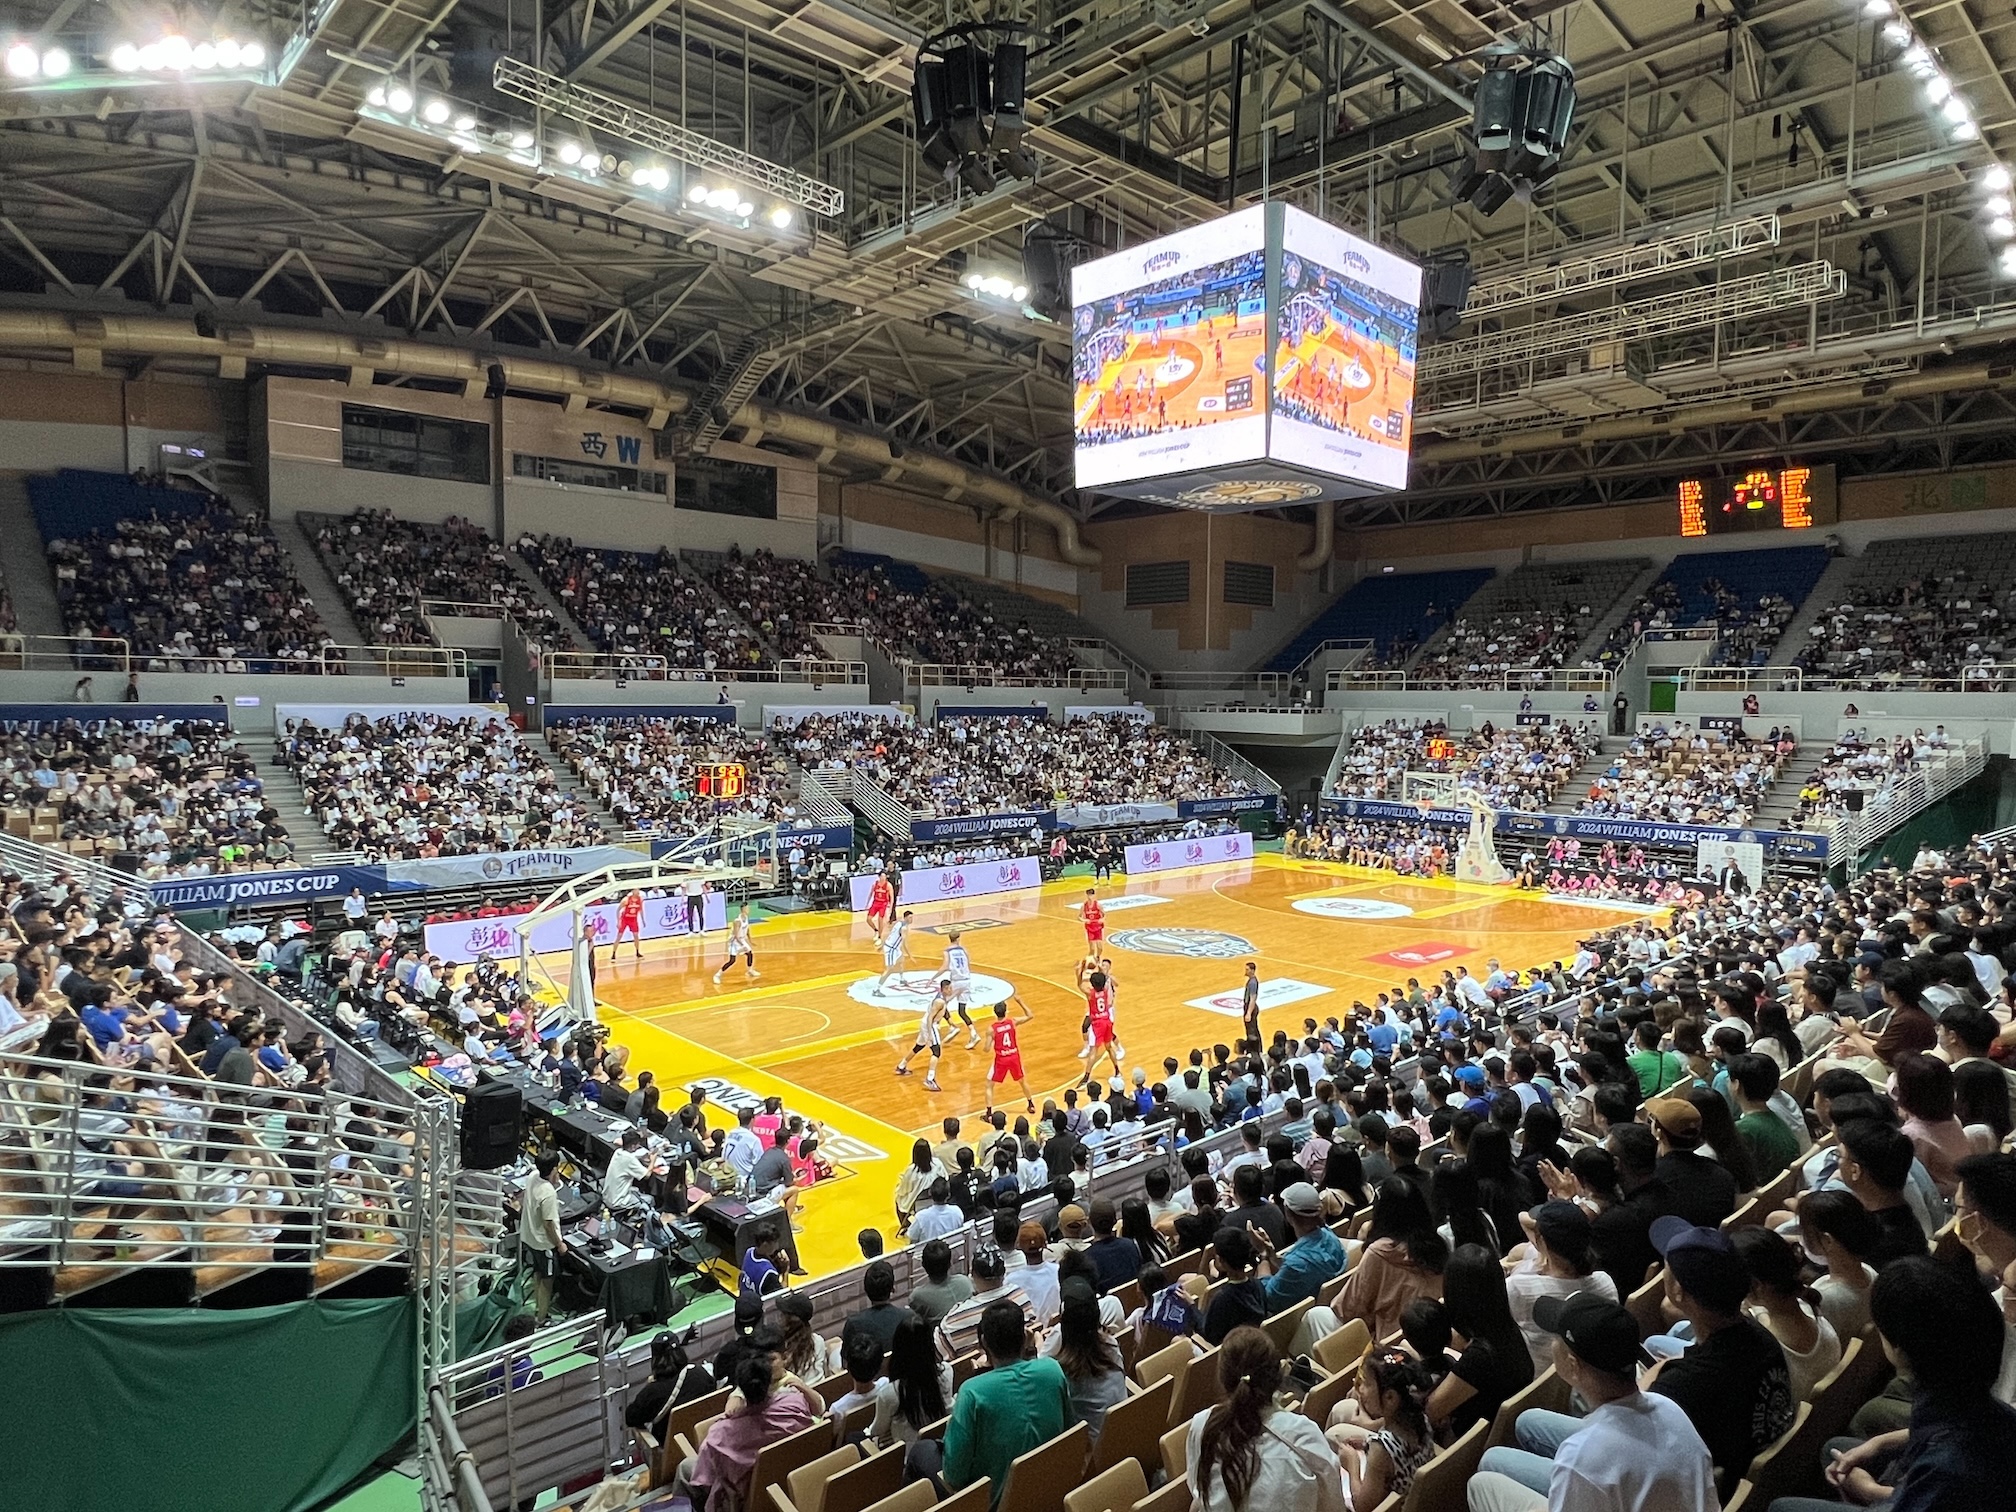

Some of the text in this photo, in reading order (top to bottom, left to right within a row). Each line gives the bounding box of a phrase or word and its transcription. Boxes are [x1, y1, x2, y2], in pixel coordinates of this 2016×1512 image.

[580, 432, 641, 464] 西 W
[1363, 805, 1383, 815] 2024
[934, 817, 1037, 835] 2024 WILLIAM JONES CUP
[1577, 822, 1728, 841] 2024 WILLIAM JONES CUP
[226, 879, 297, 902] JONES
[296, 874, 340, 892] CUP
[1097, 998, 1105, 1012] 6
[1003, 1032, 1011, 1047] 4
